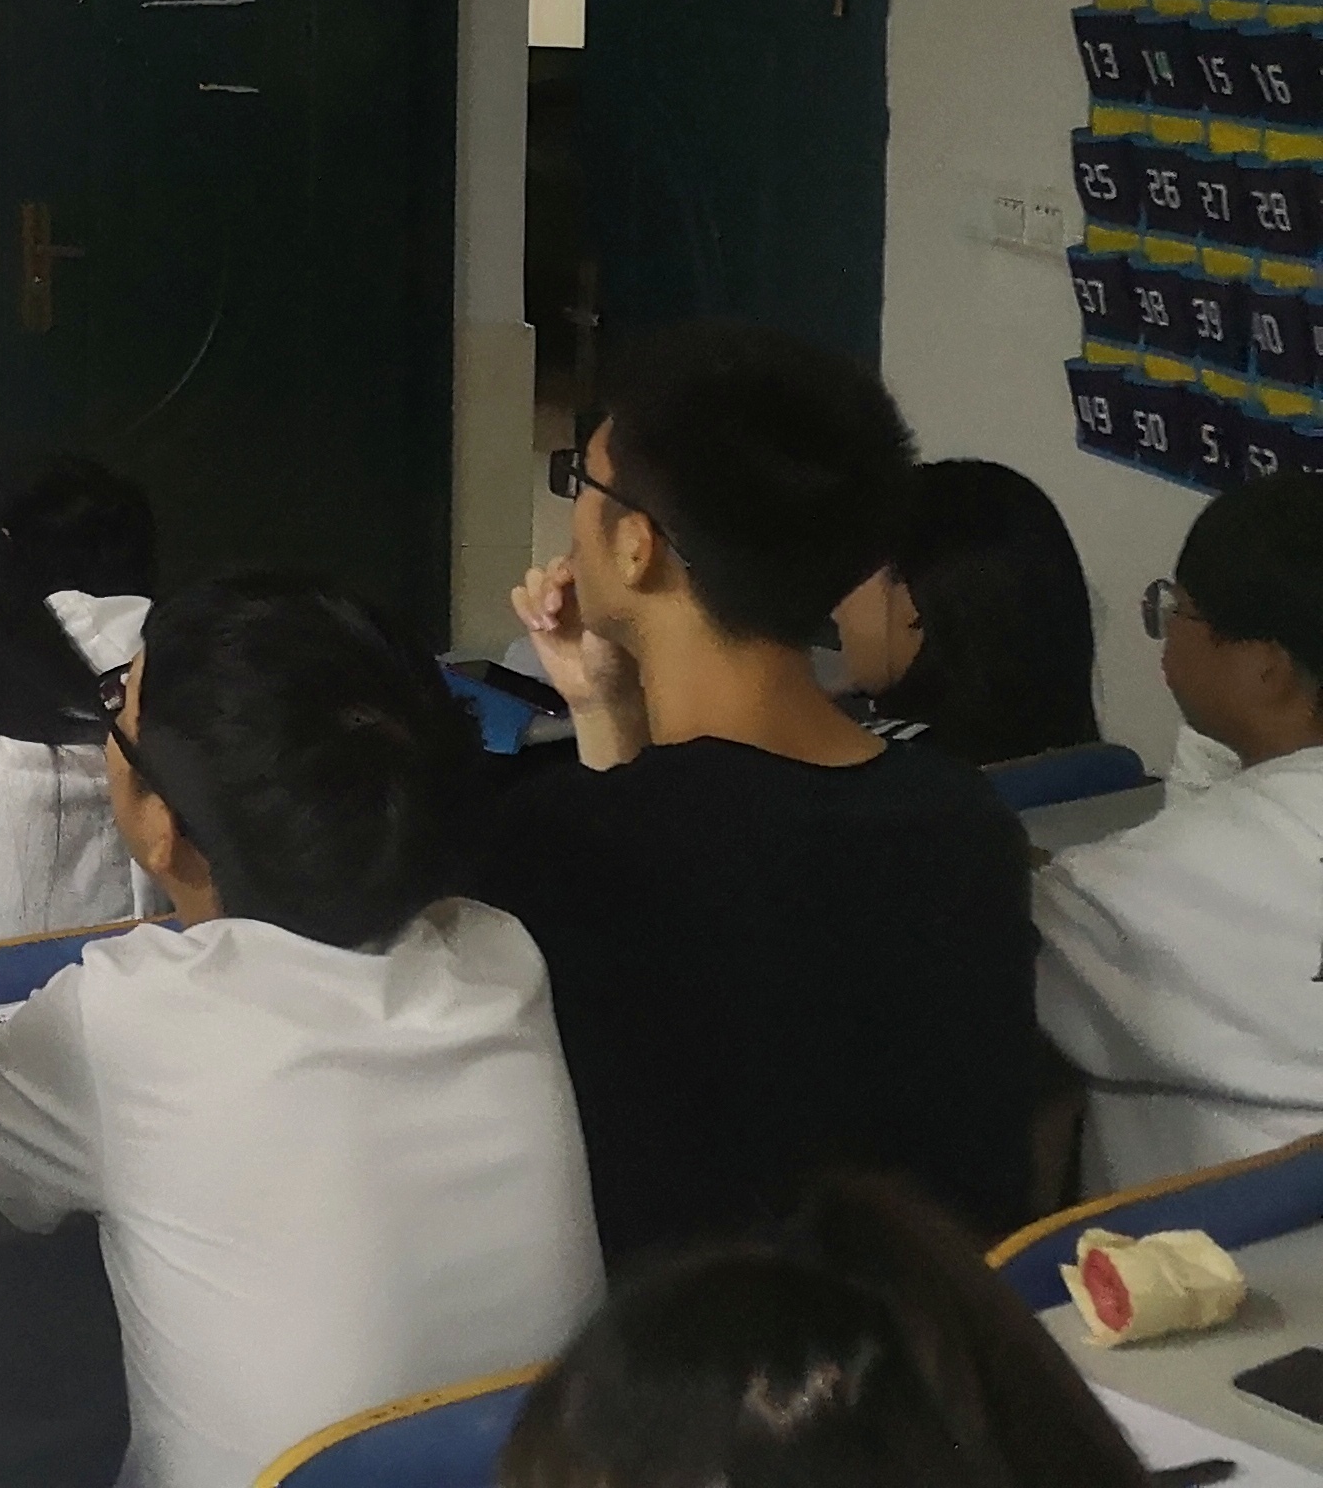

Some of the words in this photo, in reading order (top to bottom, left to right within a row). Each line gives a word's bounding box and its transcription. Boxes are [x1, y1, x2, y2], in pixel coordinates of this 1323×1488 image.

[1083, 41, 1120, 80] 13
[1141, 50, 1175, 87] 14
[1197, 54, 1233, 96] 15
[1251, 63, 1291, 105] 16
[1080, 163, 1117, 201] 25
[1146, 168, 1182, 210] 26
[1197, 181, 1231, 222] 27
[1252, 190, 1293, 232] 28
[1075, 278, 1106, 315] 37
[1134, 286, 1170, 327] 38
[1191, 297, 1225, 342] 39
[1253, 313, 1285, 355] 40
[1078, 396, 1112, 436] 49
[1133, 409, 1169, 453] 50
